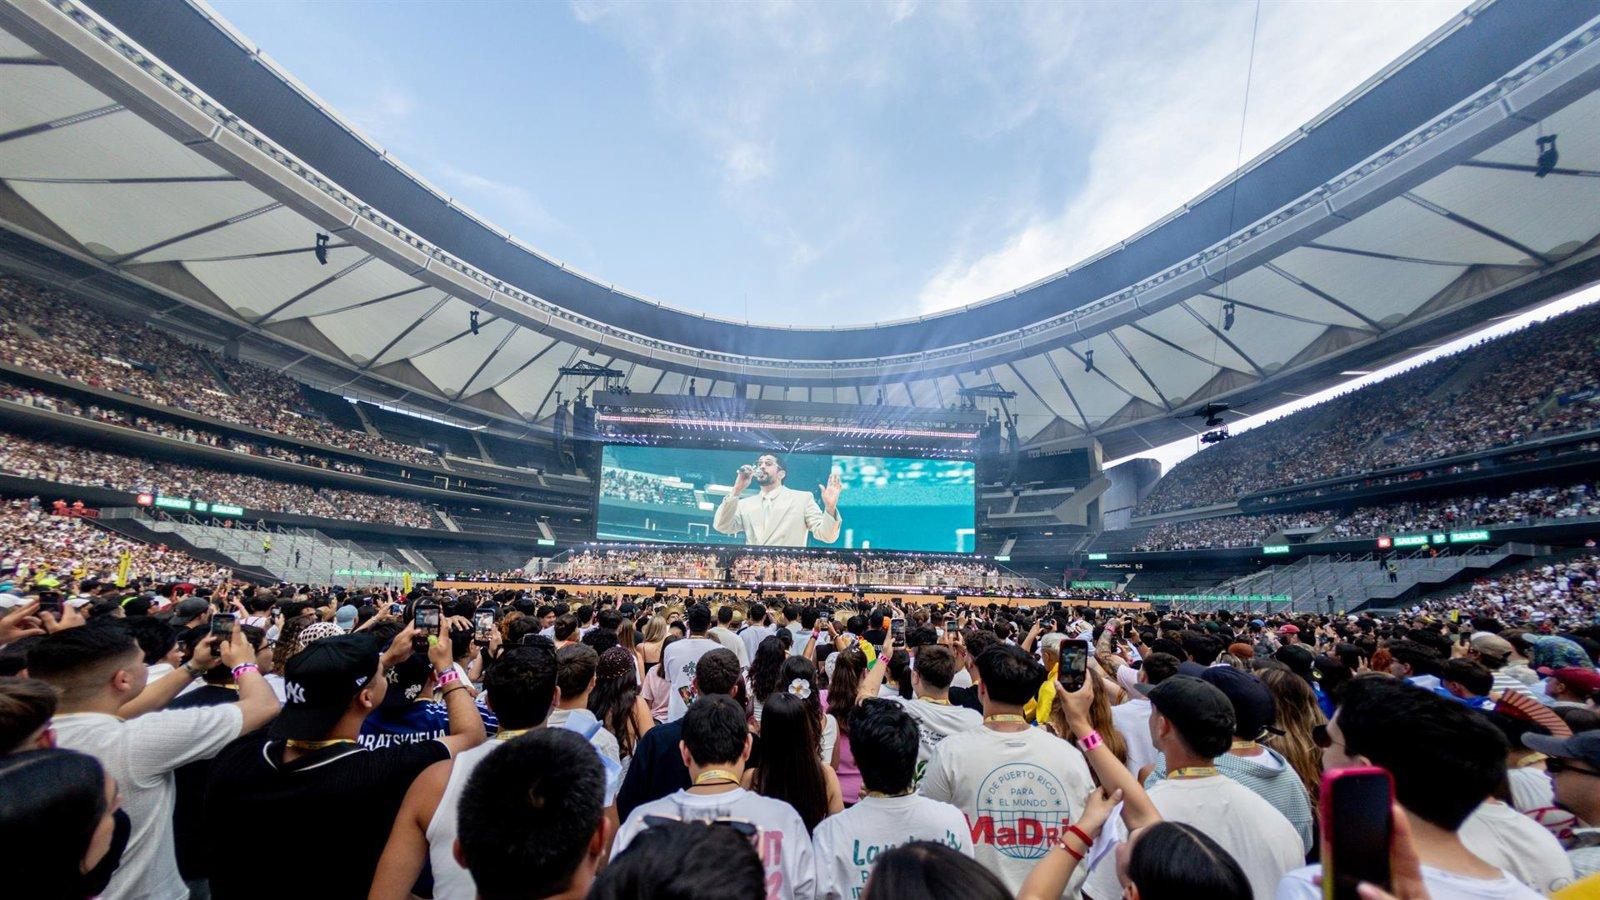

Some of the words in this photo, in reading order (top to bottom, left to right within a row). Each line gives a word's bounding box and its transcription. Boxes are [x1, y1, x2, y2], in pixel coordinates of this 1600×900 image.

[1395, 536, 1427, 545] SALIDA
[1263, 545, 1290, 553] SALIDA
[988, 782, 1000, 795] DE
[998, 770, 1035, 784] PUERTO
[1037, 775, 1057, 796] RICO
[1010, 787, 1034, 796] PARA
[999, 799, 1009, 807] EL
[1012, 799, 1048, 807] MUNDO
